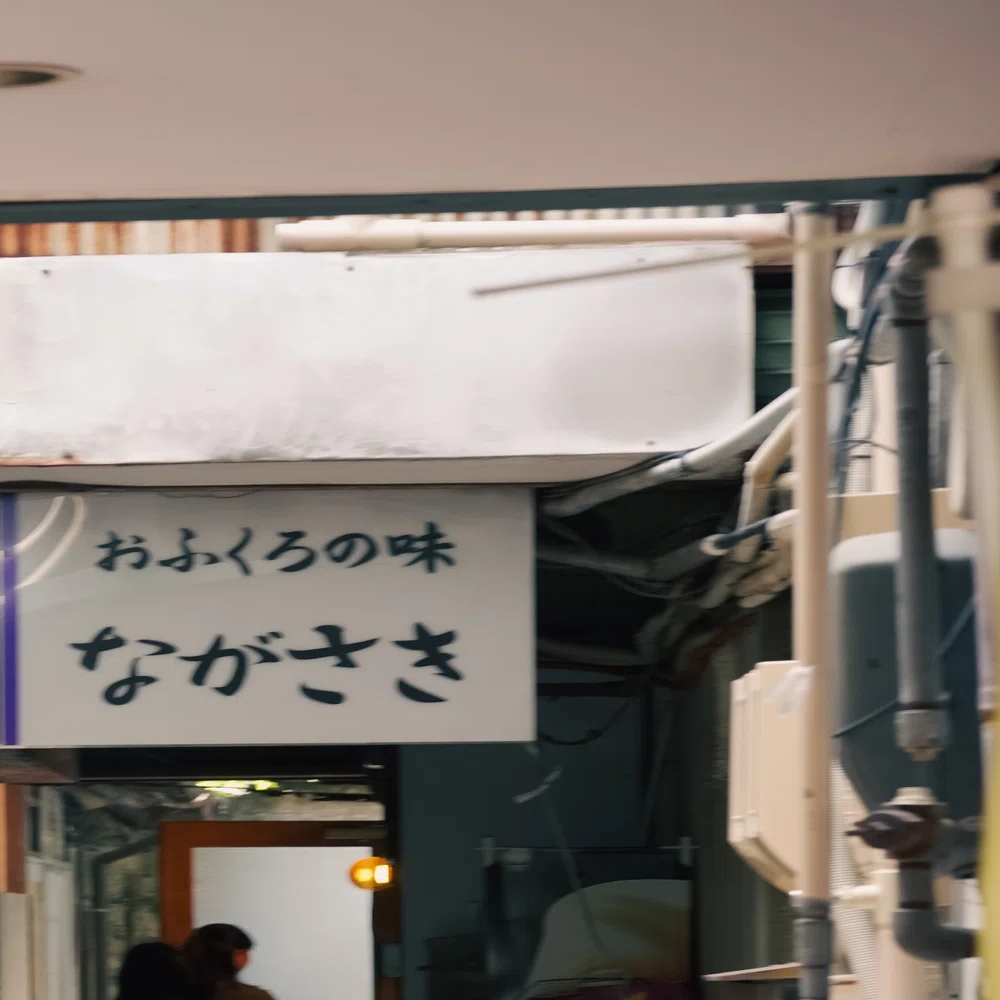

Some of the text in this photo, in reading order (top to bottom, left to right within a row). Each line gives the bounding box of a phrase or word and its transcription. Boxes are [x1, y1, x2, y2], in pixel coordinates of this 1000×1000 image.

[95, 520, 458, 576] おふくろの味
[68, 622, 466, 706] ながさき
